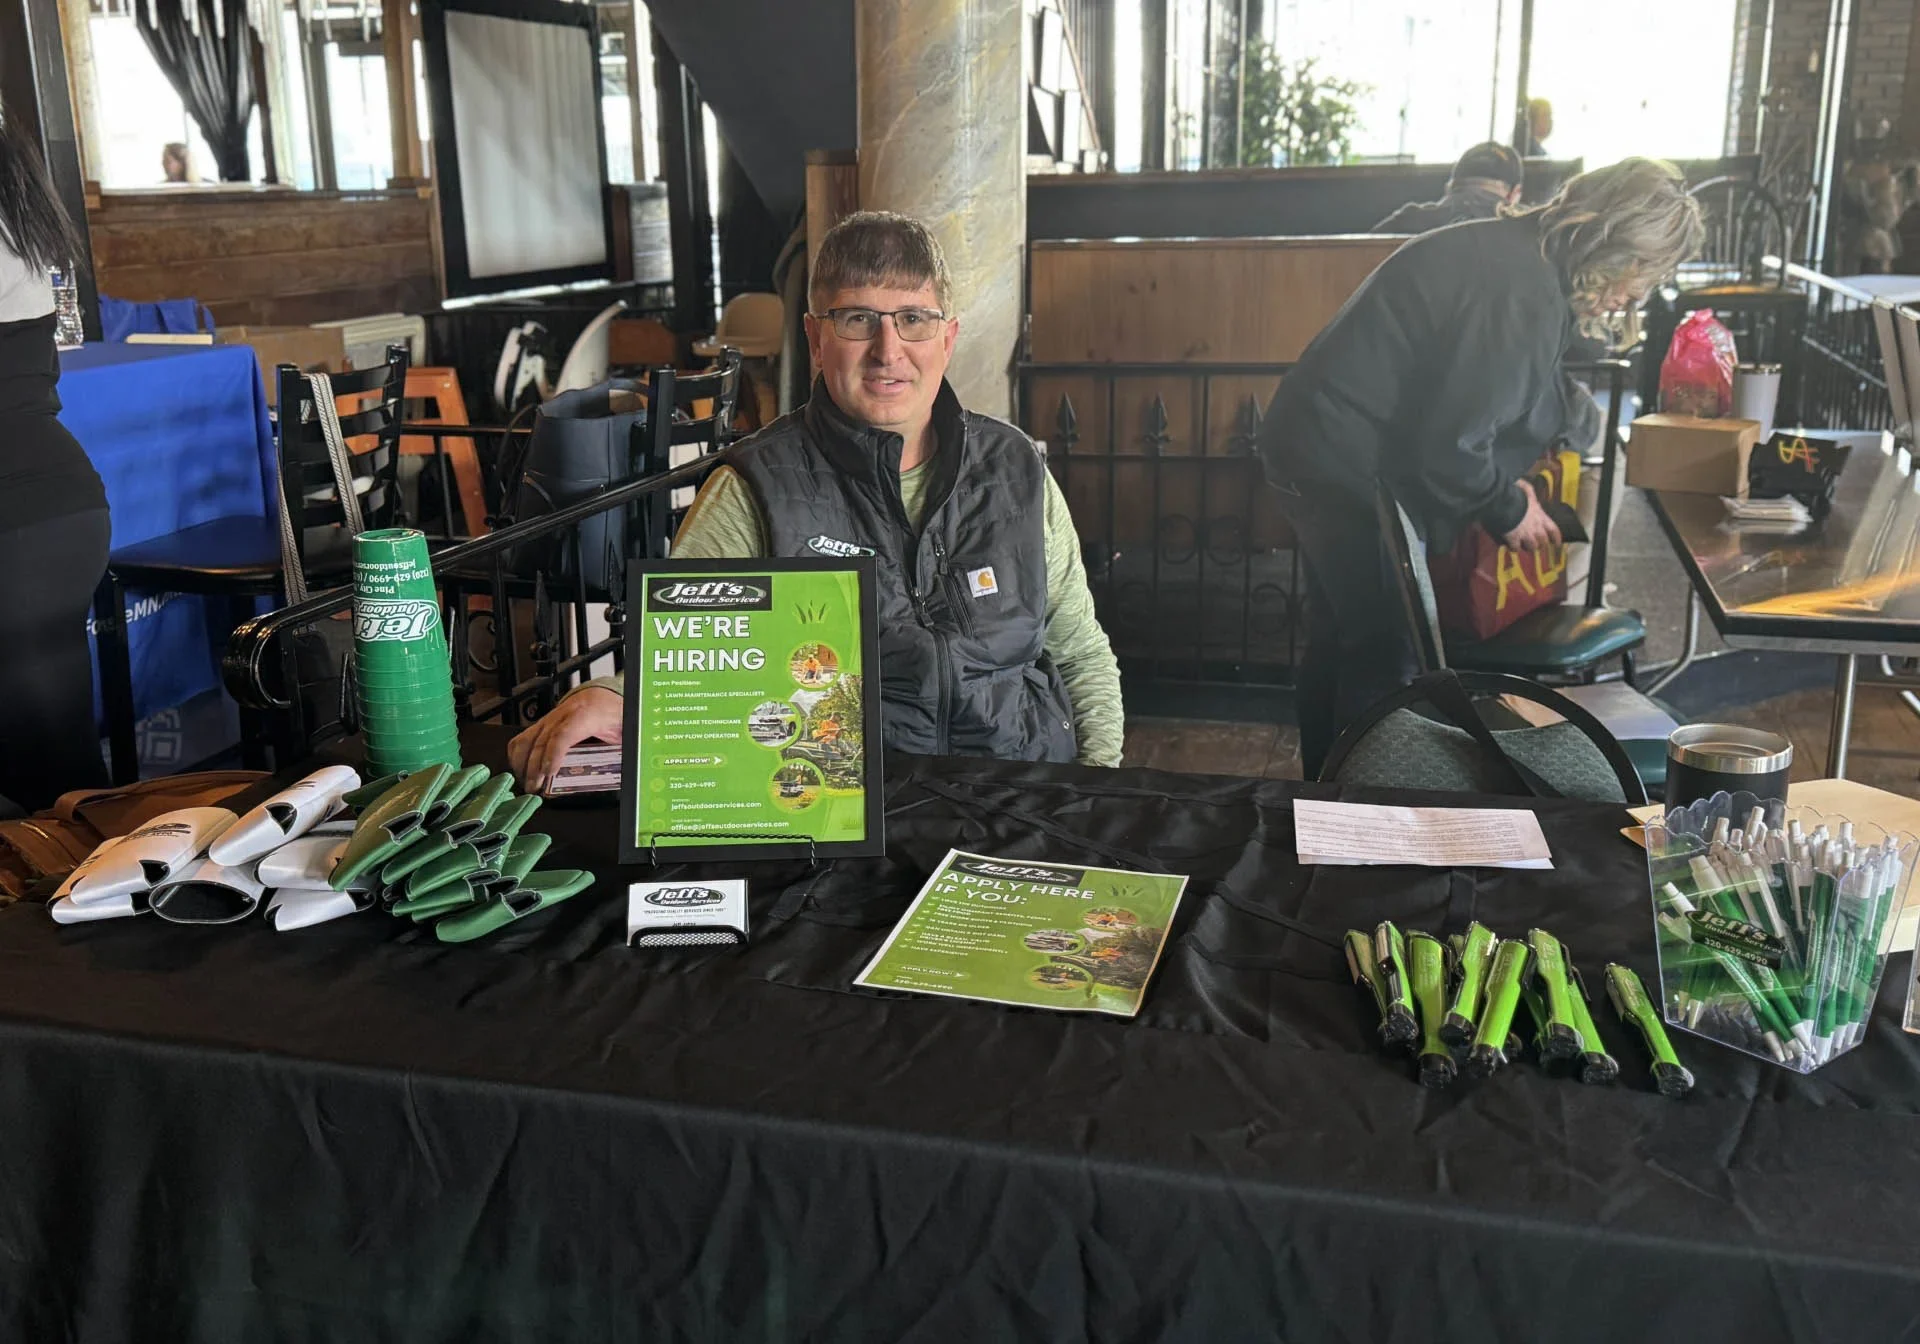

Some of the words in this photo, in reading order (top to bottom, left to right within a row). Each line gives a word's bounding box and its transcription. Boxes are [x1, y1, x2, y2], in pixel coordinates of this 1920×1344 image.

[814, 535, 861, 555] Jeff's
[369, 572, 411, 584] 629-4990
[374, 585, 395, 595] Pine
[667, 582, 744, 598] Jeff's
[675, 596, 716, 604] Outdoor
[719, 595, 761, 603] Services
[361, 602, 418, 618] Outdoor
[653, 615, 751, 639] WE'RE
[653, 647, 766, 673] HIRING
[664, 757, 689, 765] APPLY
[671, 801, 762, 811] jeffsoutdoorservices.com
[671, 821, 790, 832] office@jeffsoutdoorservices.com
[973, 862, 1054, 877] Jeff's
[656, 887, 710, 901] Jeff's
[934, 883, 959, 894] IF
[965, 888, 1028, 905] YOU:
[942, 872, 1024, 892] APPLY
[1029, 884, 1096, 900] HERE
[1698, 910, 1768, 942] Jeff's
[1703, 936, 1768, 966] 320-629-4990
